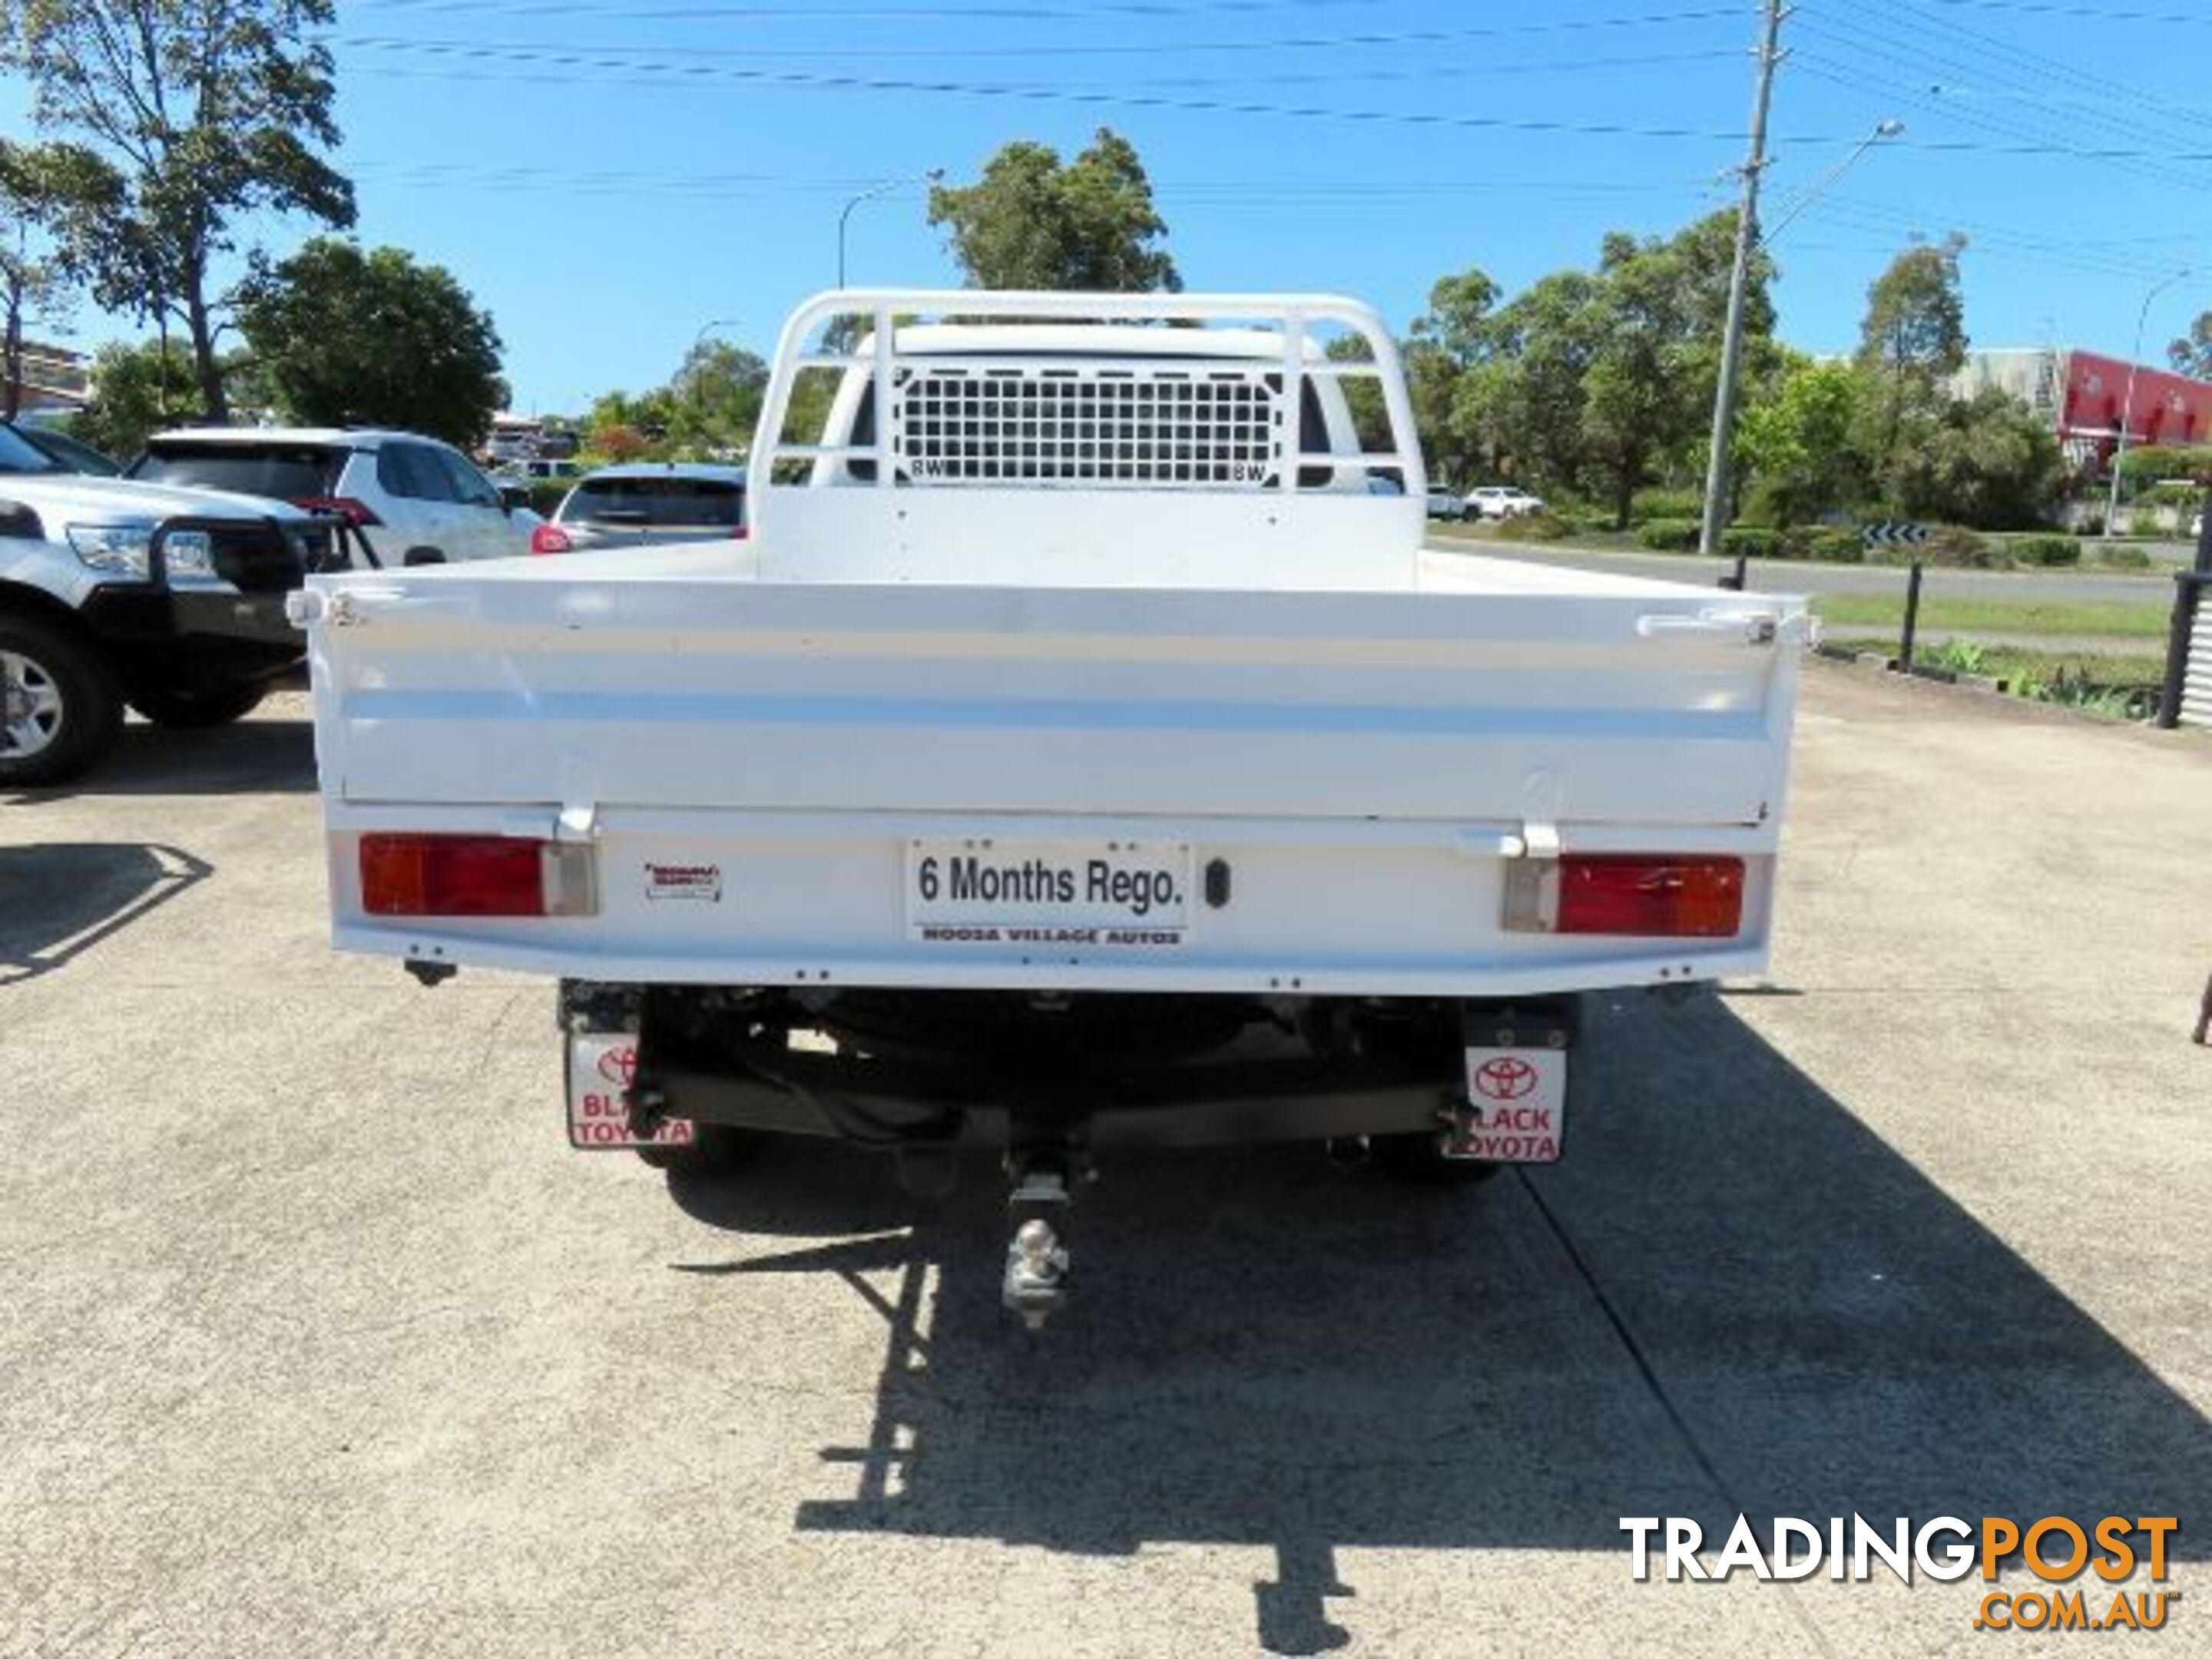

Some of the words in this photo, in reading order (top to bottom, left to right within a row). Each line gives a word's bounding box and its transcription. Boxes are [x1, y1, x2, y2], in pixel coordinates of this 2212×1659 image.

[919, 858, 938, 899] 6
[950, 858, 1075, 902] Months
[1087, 860, 1182, 915] Rego.
[1008, 929, 1098, 943] VILLAGE
[1106, 931, 1181, 945] AUTOS
